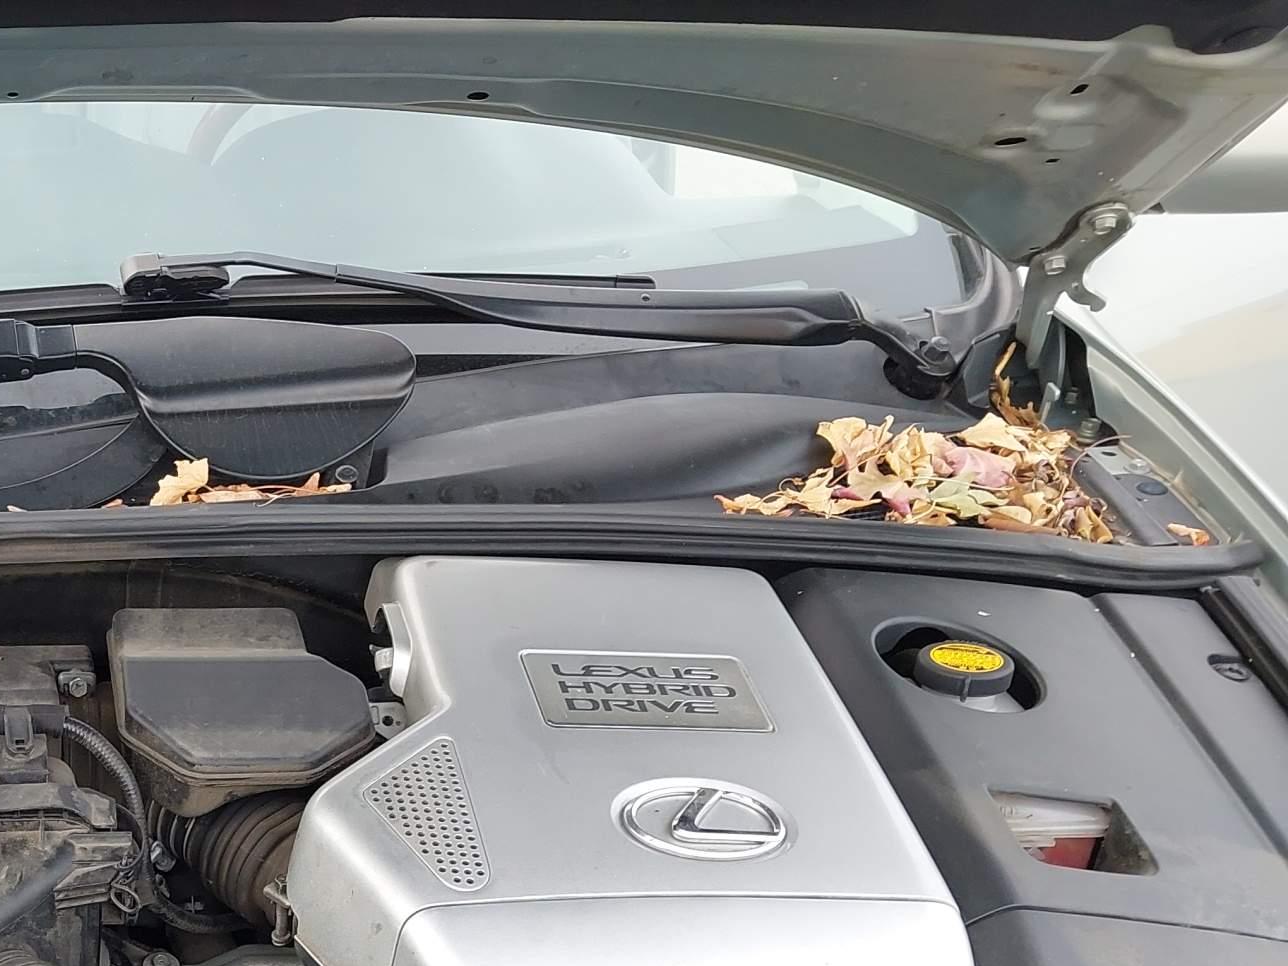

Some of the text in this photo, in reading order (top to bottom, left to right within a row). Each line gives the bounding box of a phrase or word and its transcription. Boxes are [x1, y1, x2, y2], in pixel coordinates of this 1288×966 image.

[551, 663, 720, 681] LEXUS
[558, 680, 737, 698] HYBRID
[565, 697, 720, 714] DRIVE
